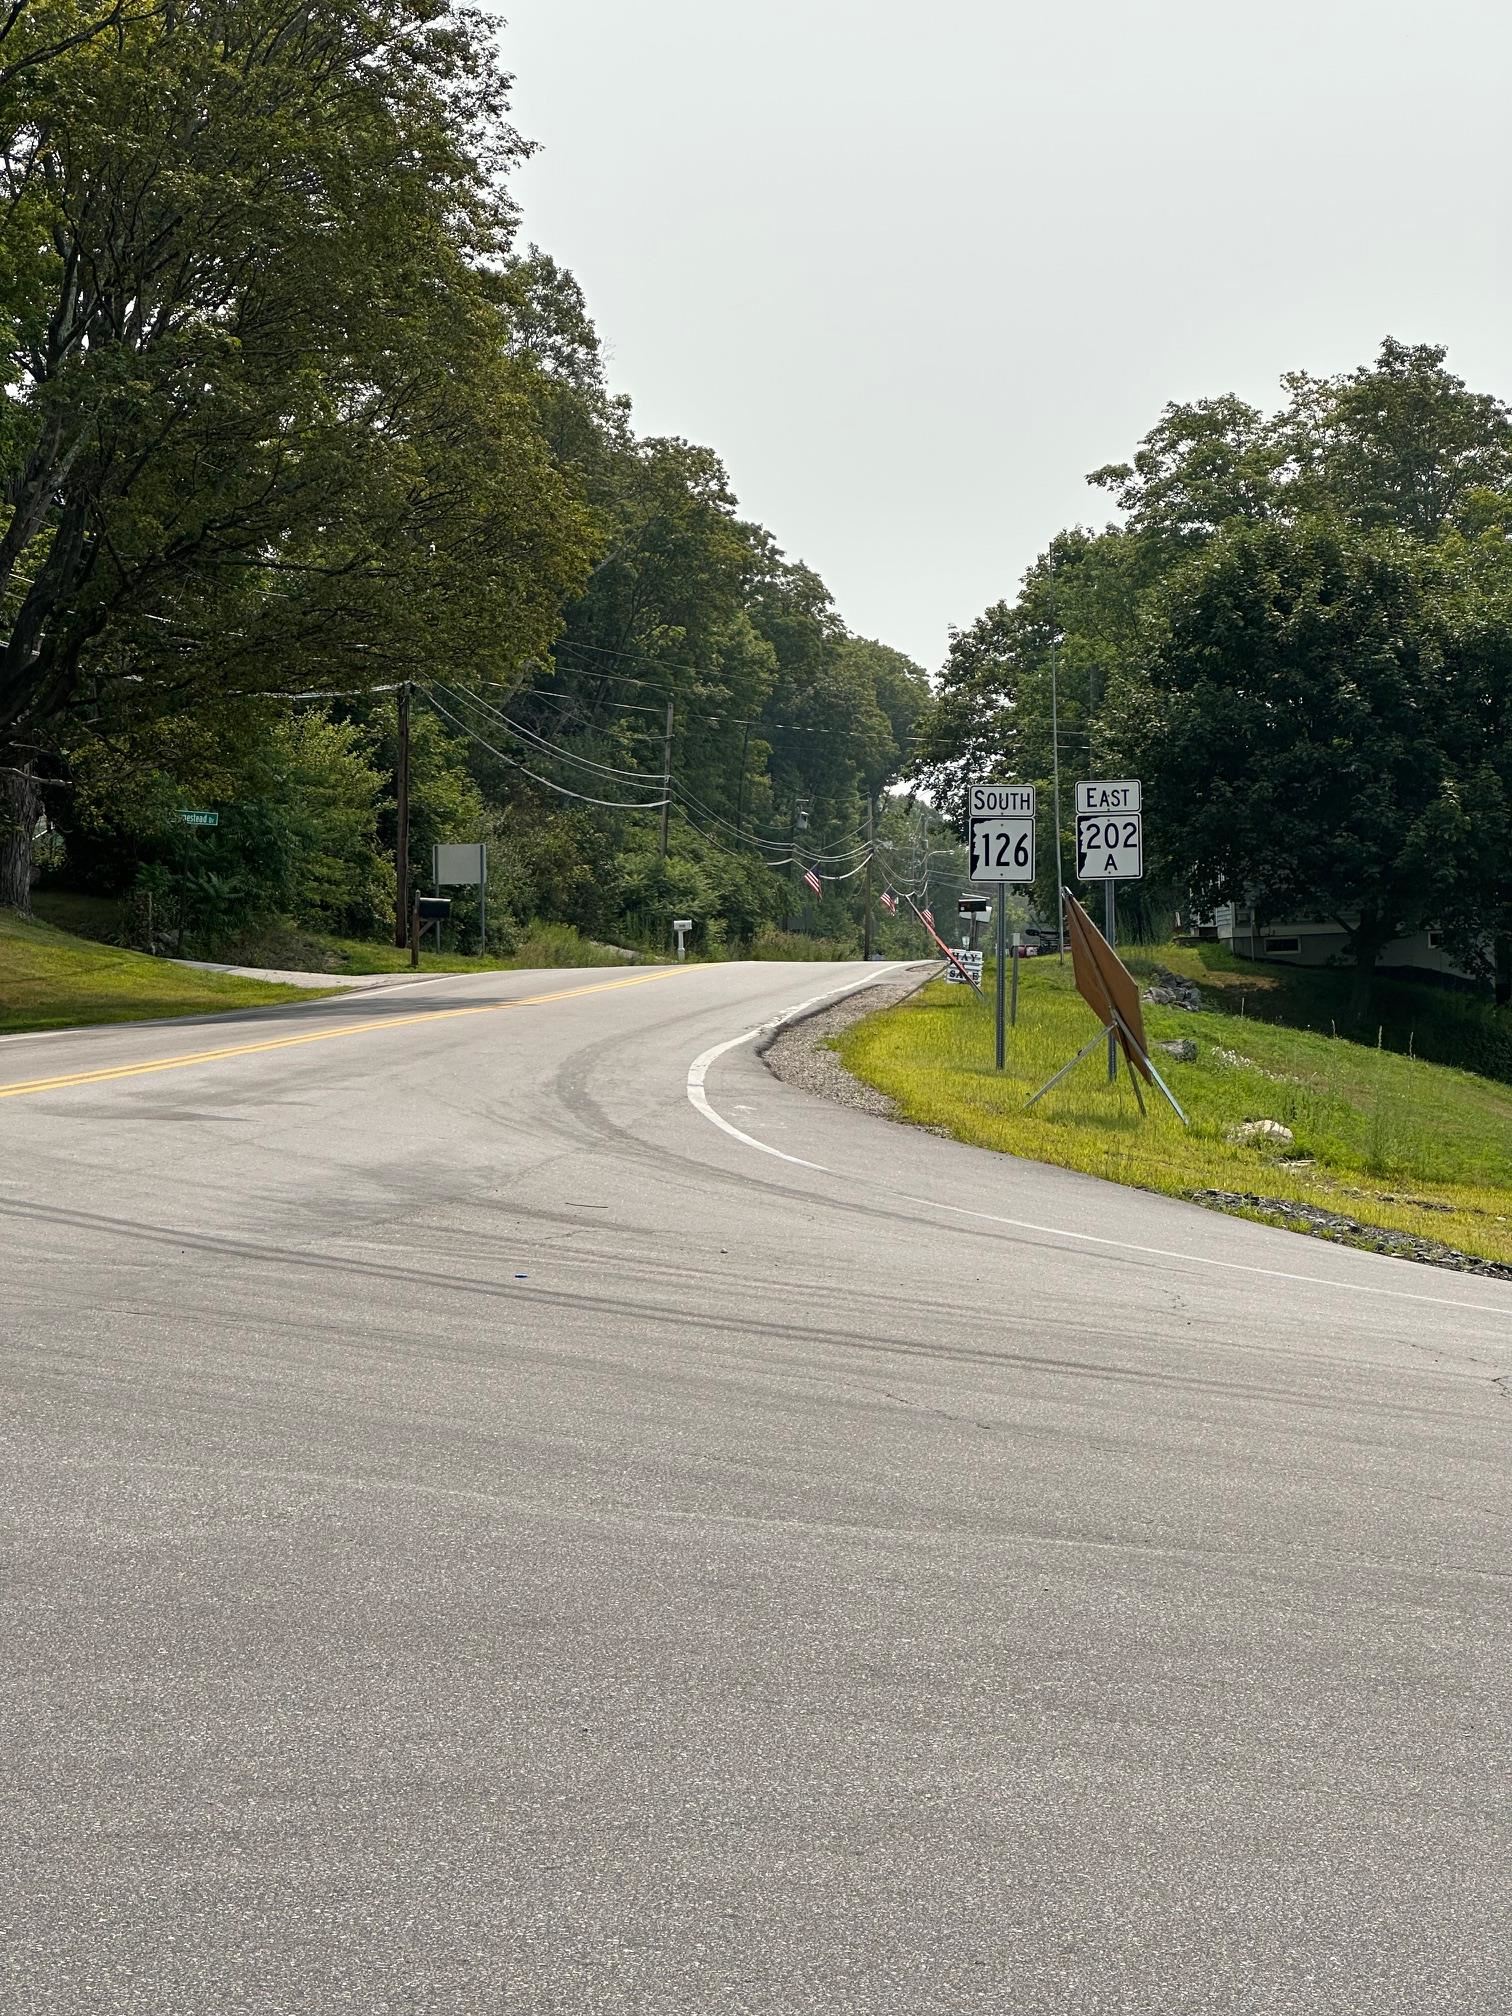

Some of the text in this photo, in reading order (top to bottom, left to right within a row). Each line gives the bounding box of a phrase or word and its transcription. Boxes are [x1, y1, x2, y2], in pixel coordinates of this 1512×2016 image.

[974, 790, 1031, 811] SOUTH
[1086, 787, 1130, 808] EAST
[1086, 822, 1138, 850] 202
[982, 832, 1029, 867] 126
[1104, 853, 1118, 871] A
[950, 970, 979, 981] SAE
